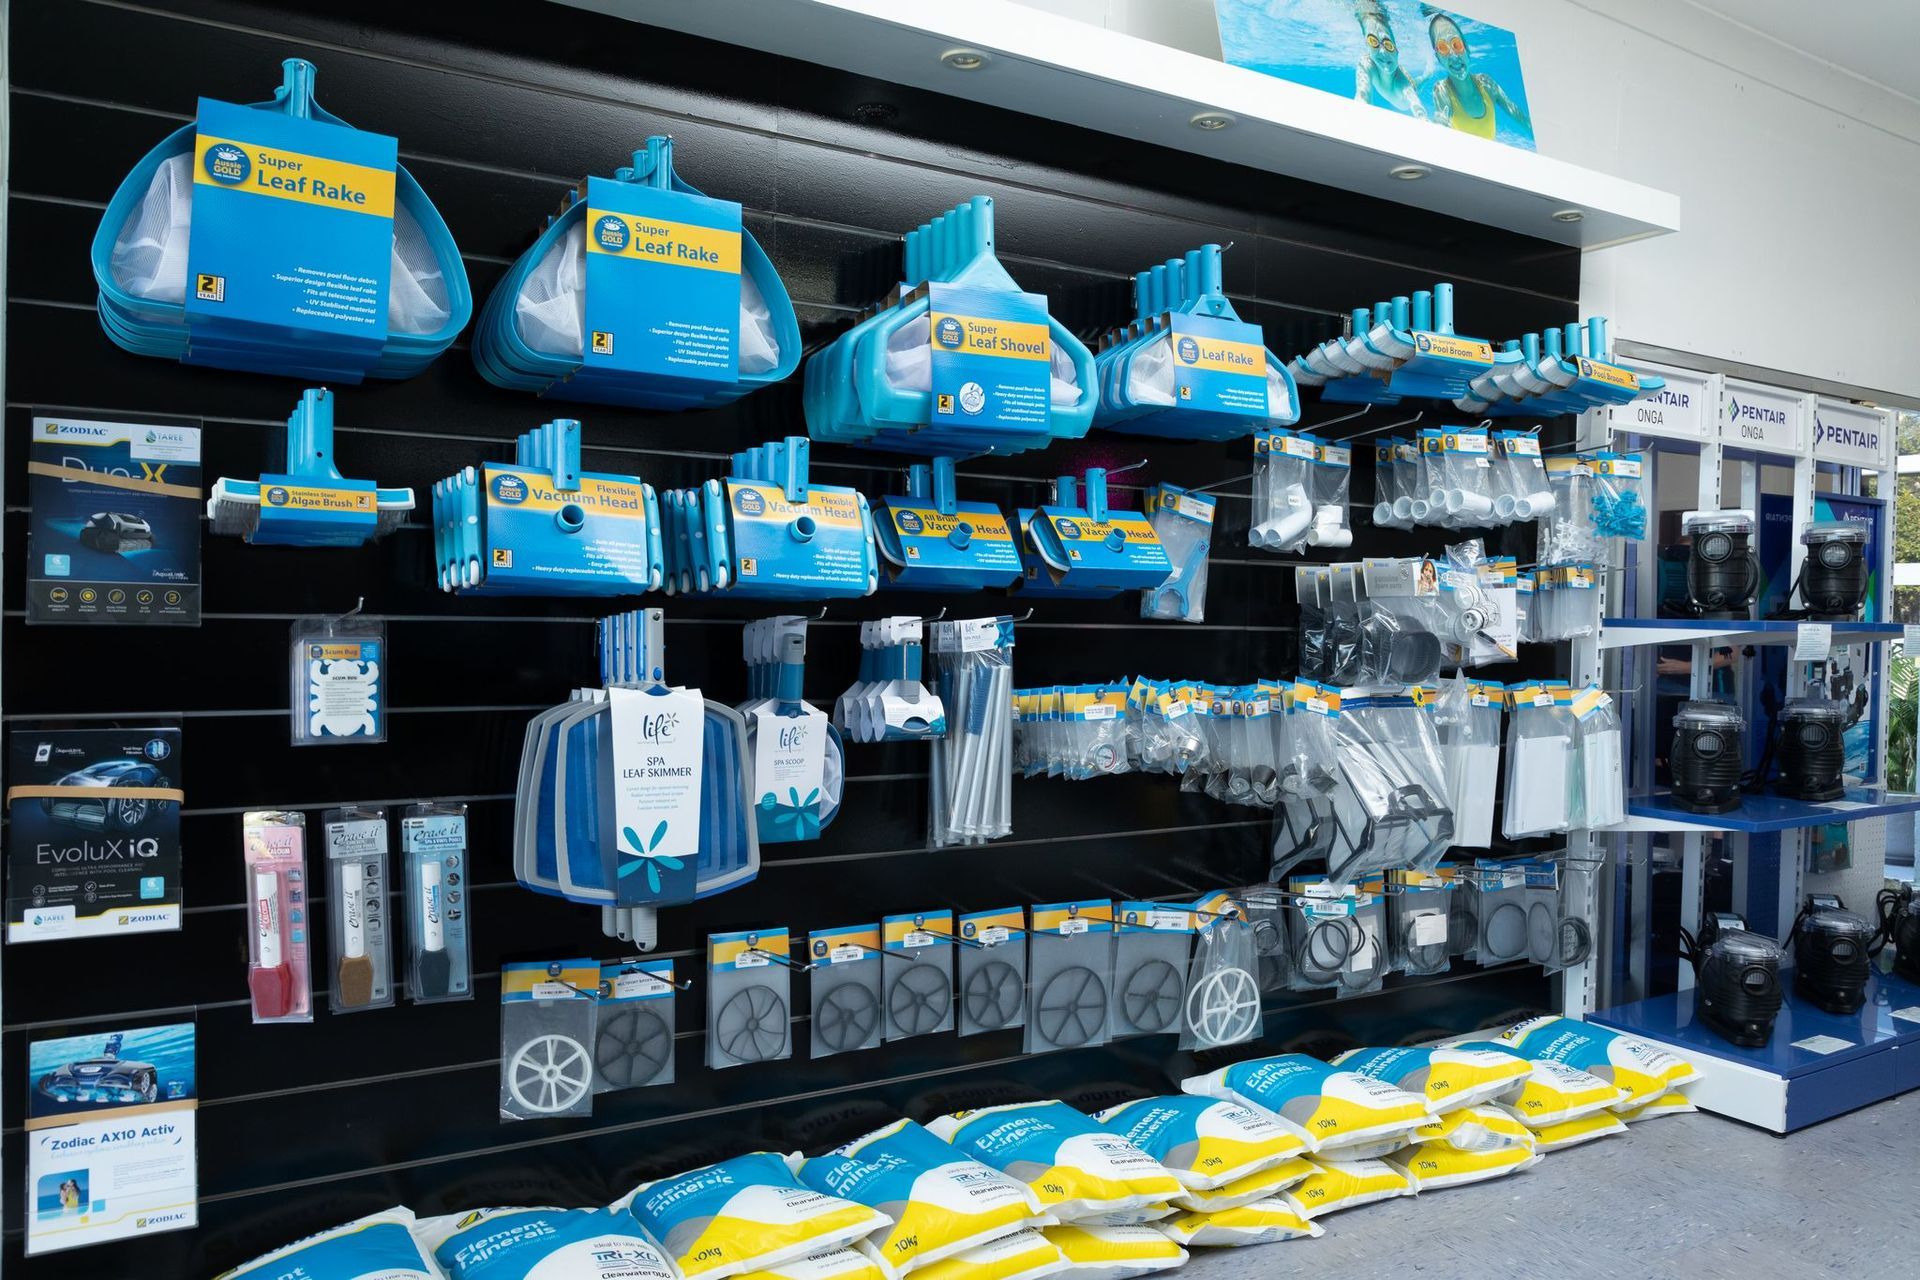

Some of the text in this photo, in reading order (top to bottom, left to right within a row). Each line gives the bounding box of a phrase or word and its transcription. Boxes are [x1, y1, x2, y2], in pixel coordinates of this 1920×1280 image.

[258, 153, 303, 171] Super
[213, 165, 241, 176] GOLD
[258, 169, 366, 205] Leaf Rake
[635, 222, 670, 237] Super
[601, 235, 623, 244] GOLD
[635, 237, 719, 264] Leaf Rake
[298, 267, 326, 277] Removes
[358, 277, 377, 285] debris
[202, 276, 214, 292] 2
[276, 273, 303, 283] Superior
[304, 278, 325, 287] design
[362, 287, 377, 295] rake
[328, 292, 359, 302] telescopic
[359, 297, 377, 305] poles
[296, 307, 335, 318] Replaceable
[335, 313, 364, 323] polyester
[349, 305, 377, 314] material
[968, 322, 997, 335] Super
[596, 333, 605, 347] 2
[969, 335, 1045, 354] Leaf Shovel
[1202, 348, 1254, 366] Leaf Rake
[1433, 344, 1473, 357] Pool Broom
[1593, 370, 1625, 384] Pool Broom
[941, 396, 948, 408] 2
[1638, 408, 1664, 425] ONGA
[1742, 405, 1786, 425] PENTAIR
[59, 426, 107, 436] ZODIAC
[157, 434, 184, 442] TAREE
[1741, 424, 1764, 441] ONGA
[1827, 427, 1878, 450] PENTAIR
[596, 484, 636, 496] Flexible
[291, 496, 353, 508] Algae Brush
[532, 489, 639, 510] Vacuum Head
[821, 496, 853, 507] Flexible
[768, 501, 856, 519] Vacuum Head
[926, 521, 1007, 535] Vacu Head
[1083, 527, 1154, 539] Vacu Head
[496, 550, 505, 562] 2
[744, 560, 751, 570] 2
[643, 713, 672, 745] life
[780, 727, 801, 752] life
[647, 757, 665, 766] SPA
[623, 767, 692, 778] LEAF SKIMMER
[334, 825, 379, 845] erase it
[414, 823, 459, 841] erase it
[37, 838, 159, 864] EvoluX iQ
[130, 914, 168, 923] ZODIAC
[1257, 1065, 1313, 1093] minerals
[1431, 1080, 1449, 1092] 10kg
[1525, 1100, 1543, 1109] 10kg
[1317, 1118, 1337, 1129] 10kg
[51, 1137, 95, 1151] Zodiac
[101, 1129, 136, 1143] AX10
[141, 1124, 175, 1137] Activ
[1203, 1156, 1223, 1169] 10kg
[1418, 1160, 1438, 1171] 10kg
[646, 1167, 727, 1212] Element
[652, 1175, 735, 1217] minerals
[1043, 1184, 1064, 1195] 10kg
[1305, 1188, 1325, 1199] 10kg
[148, 1213, 186, 1225] ZODIAC
[455, 1220, 549, 1262] Element
[895, 1235, 918, 1253] 10kg
[694, 1247, 722, 1262] 10kg
